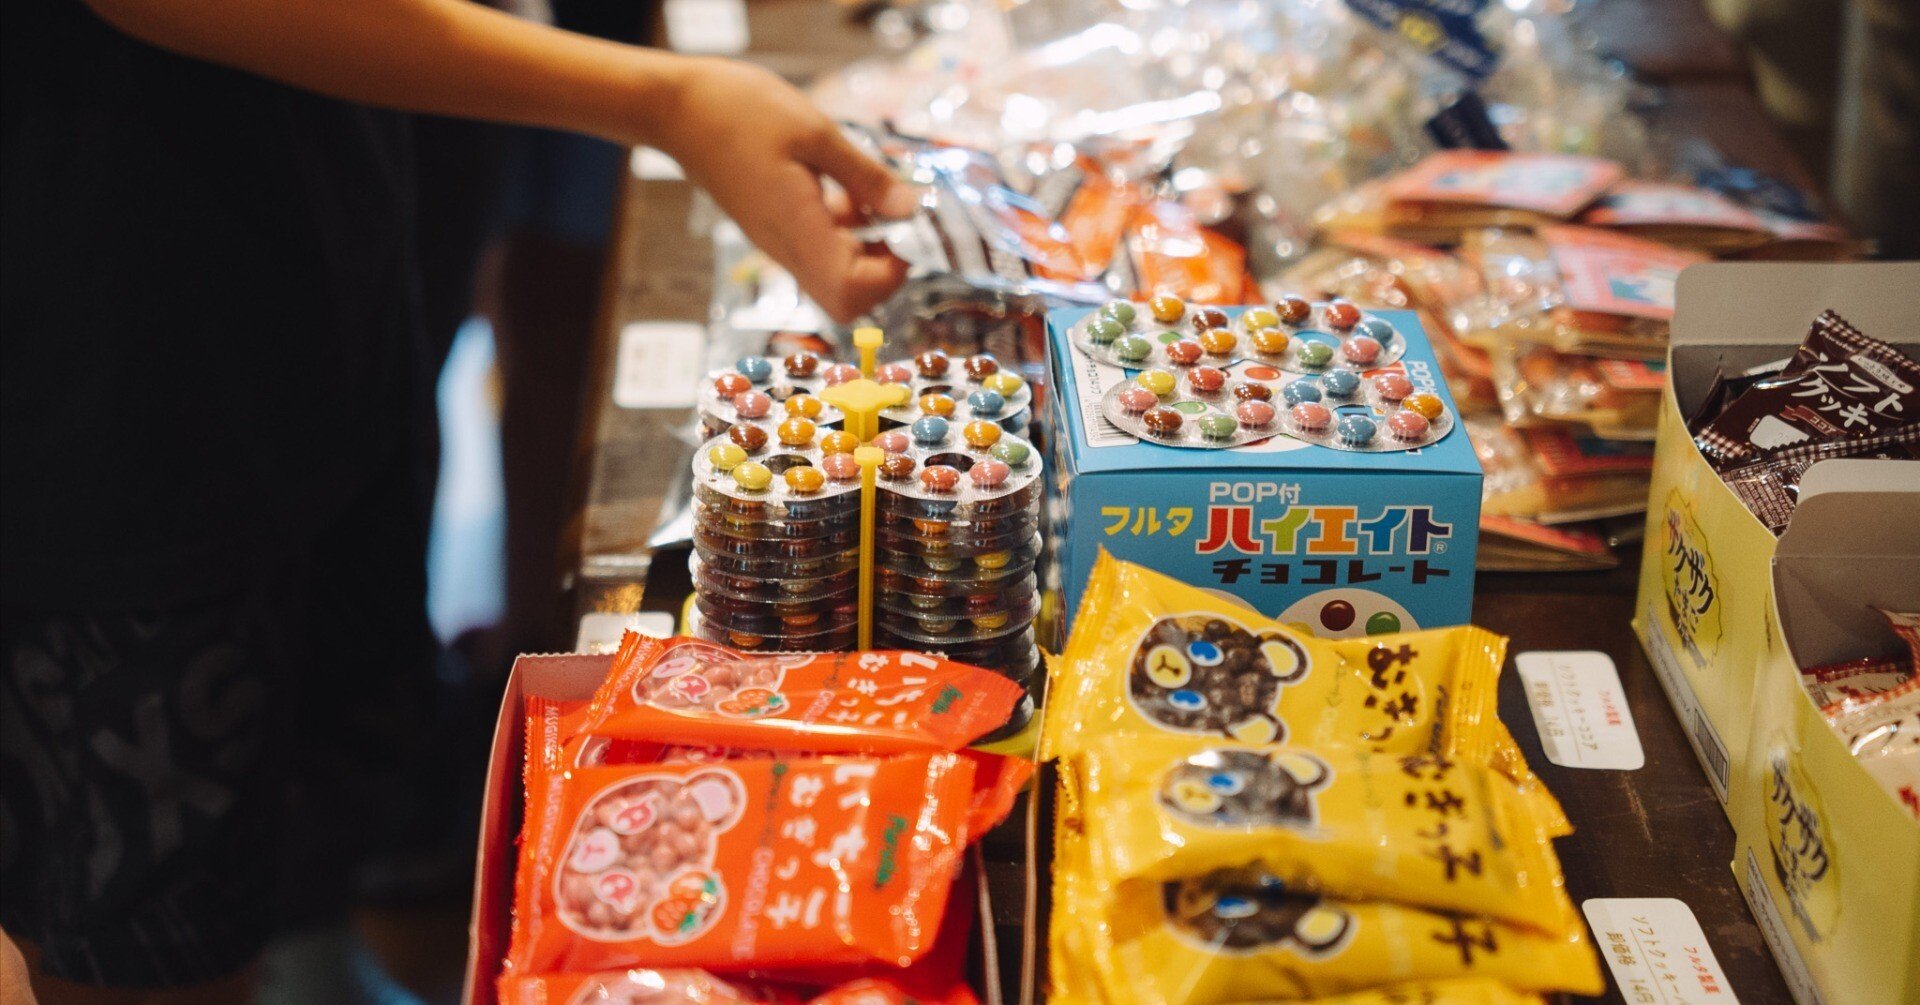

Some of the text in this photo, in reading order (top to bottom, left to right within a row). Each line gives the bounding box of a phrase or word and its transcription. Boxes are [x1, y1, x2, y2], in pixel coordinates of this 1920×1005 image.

[1813, 352, 1904, 413] ソフト
[1809, 415, 1837, 435] ココア
[1209, 482, 1302, 504] POP付
[1101, 506, 1194, 537] フルタ
[1194, 504, 1454, 556] ハイエイト
[1212, 557, 1451, 585] チョコレート
[1364, 643, 1419, 754] むぎっ
